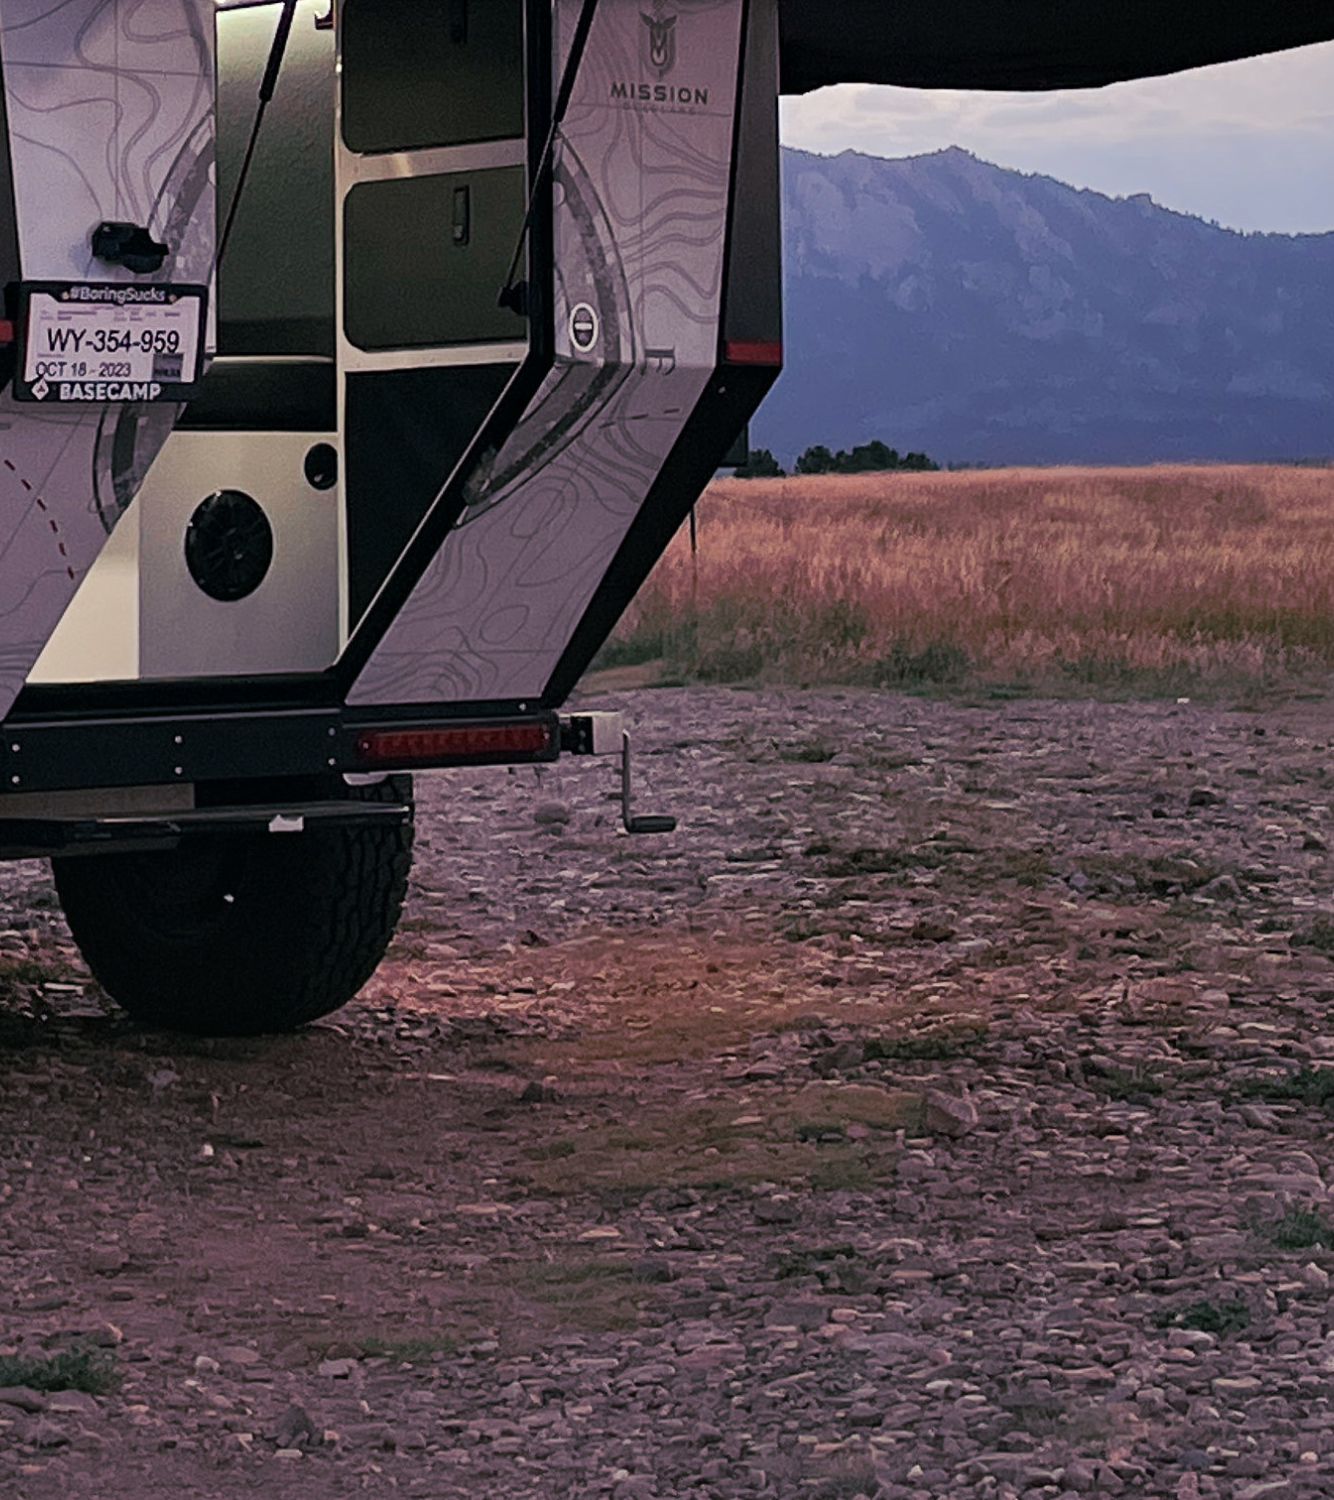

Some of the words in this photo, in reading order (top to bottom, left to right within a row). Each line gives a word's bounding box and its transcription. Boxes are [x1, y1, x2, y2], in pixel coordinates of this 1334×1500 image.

[610, 81, 708, 105] MISSION
[68, 286, 166, 304] #BoringSucks
[47, 328, 180, 354] WY-354-959
[35, 361, 67, 377] OCT
[71, 361, 87, 377] 18
[98, 361, 132, 377] 2023
[59, 382, 162, 400] BASECAMP
